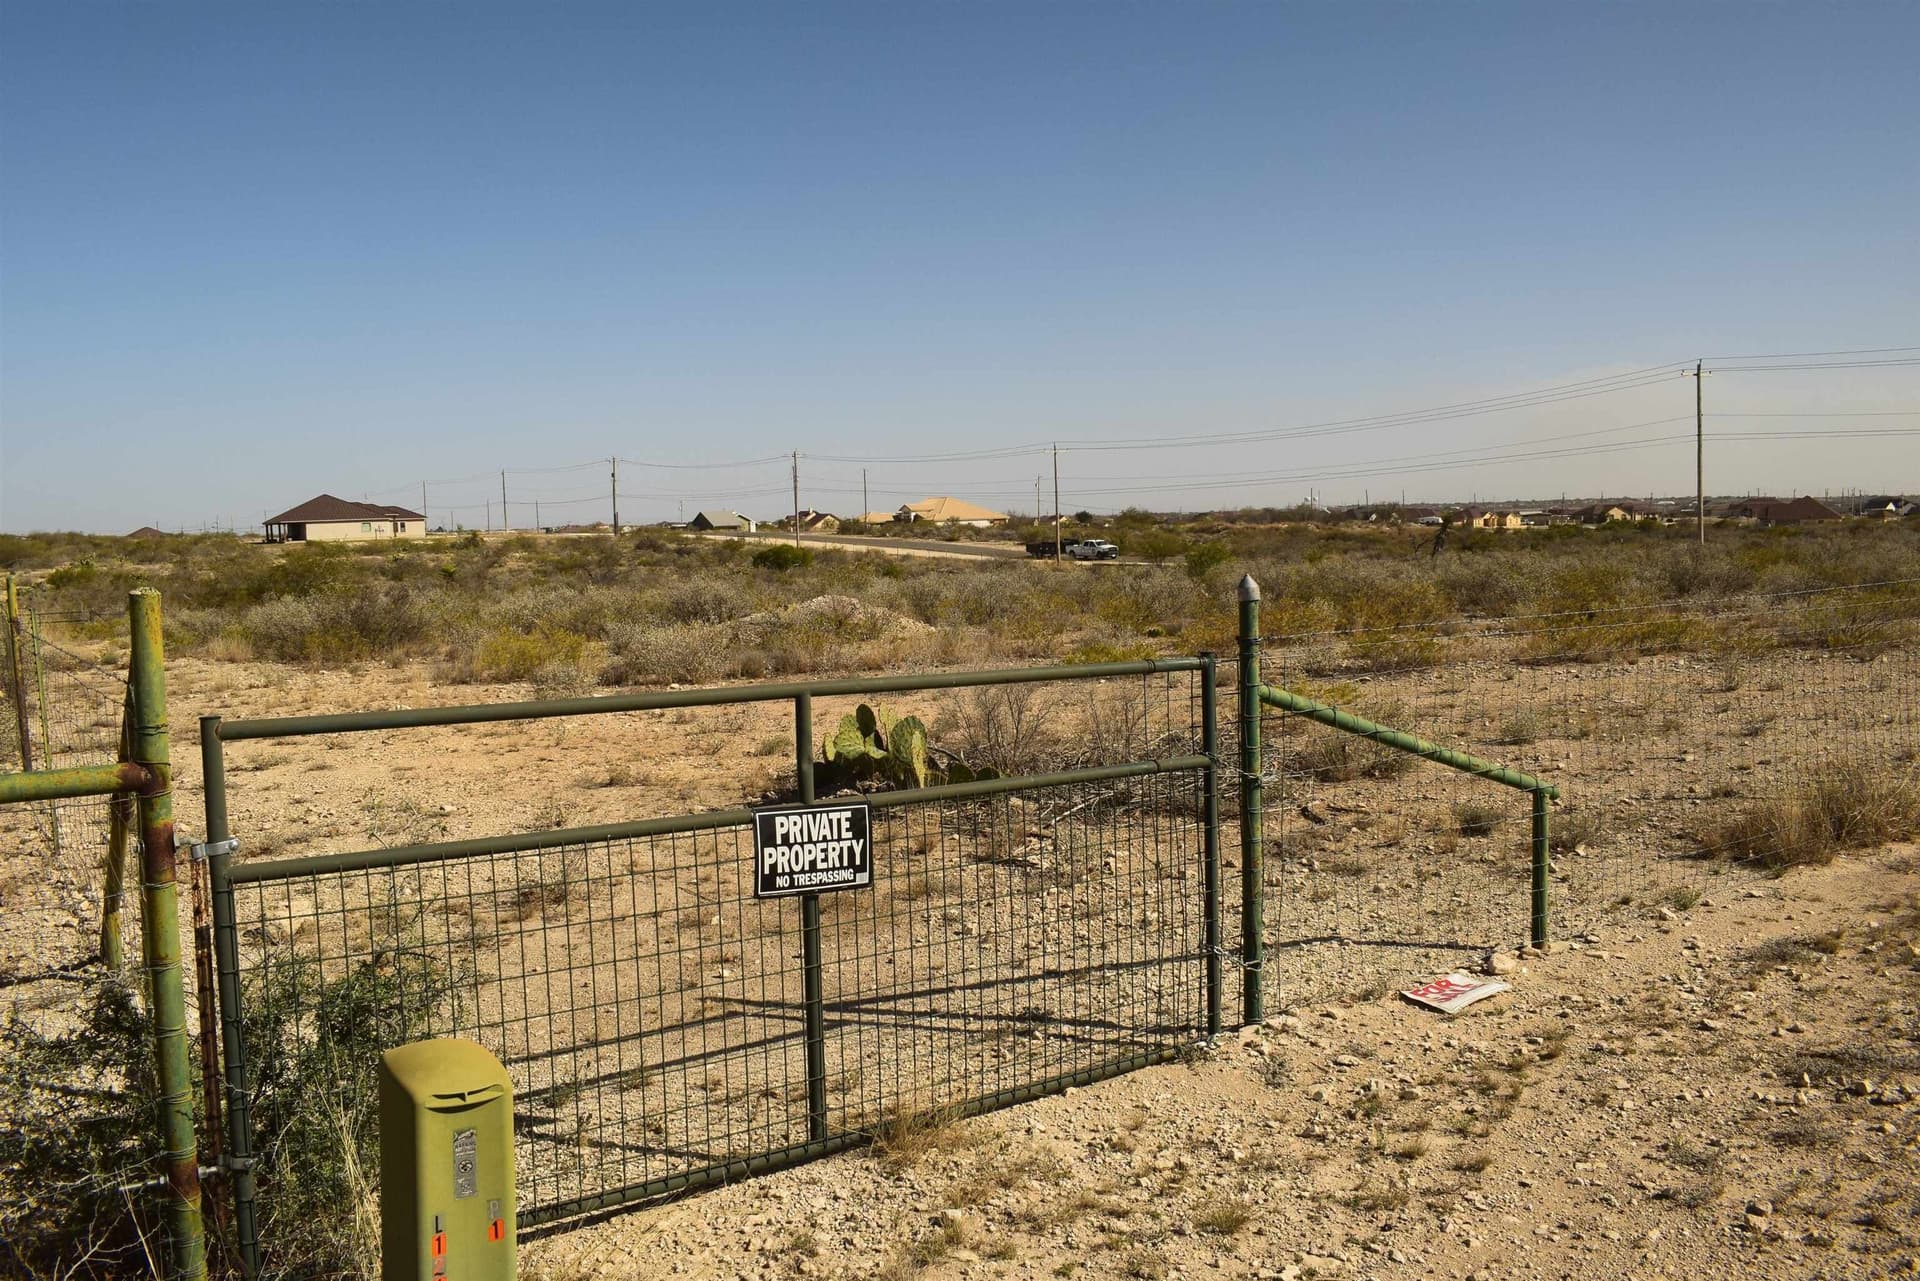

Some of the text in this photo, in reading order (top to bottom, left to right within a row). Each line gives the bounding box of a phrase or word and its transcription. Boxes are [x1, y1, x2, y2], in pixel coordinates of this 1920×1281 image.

[775, 811, 852, 844] PRIVATE
[763, 839, 864, 874] PROPERTY
[776, 869, 854, 888] NO TRESPASSING
[492, 1220, 499, 1239] 1
[435, 1235, 442, 1255] 1
